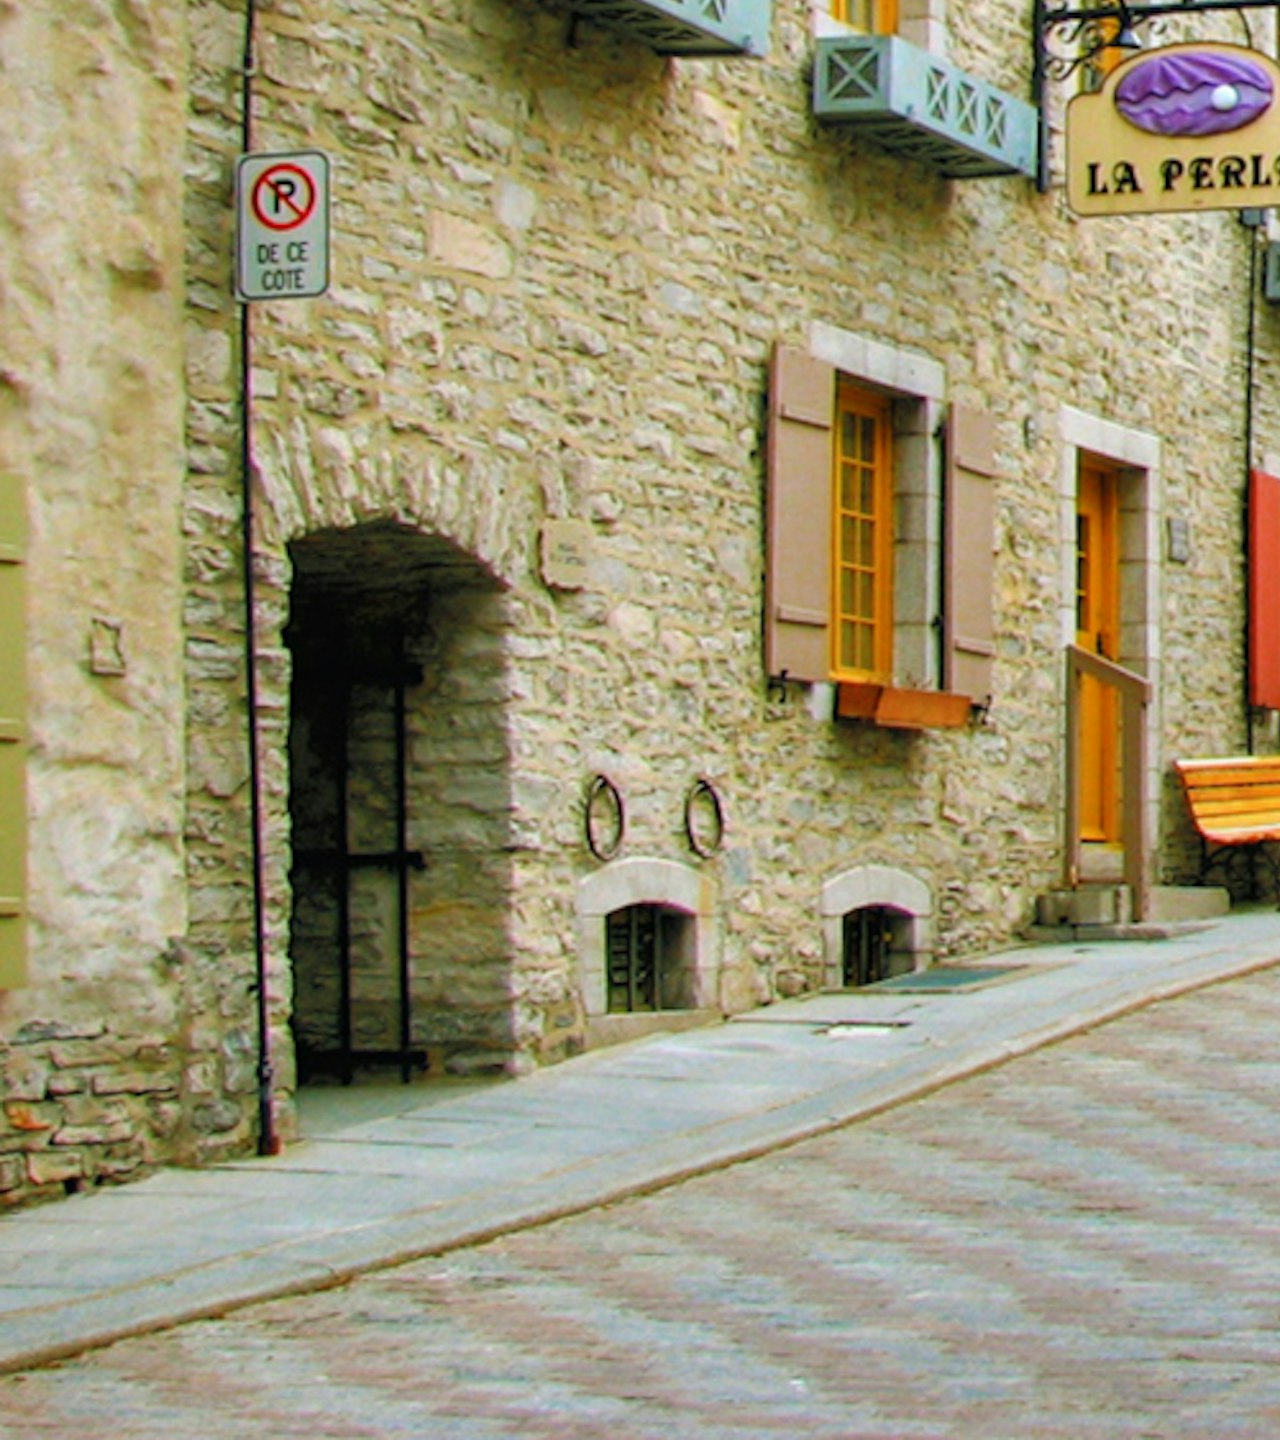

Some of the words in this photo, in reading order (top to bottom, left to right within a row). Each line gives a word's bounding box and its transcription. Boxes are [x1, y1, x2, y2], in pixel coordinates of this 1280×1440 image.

[1086, 161, 1142, 197] LA
[257, 243, 280, 264] DE
[287, 241, 309, 262] CE
